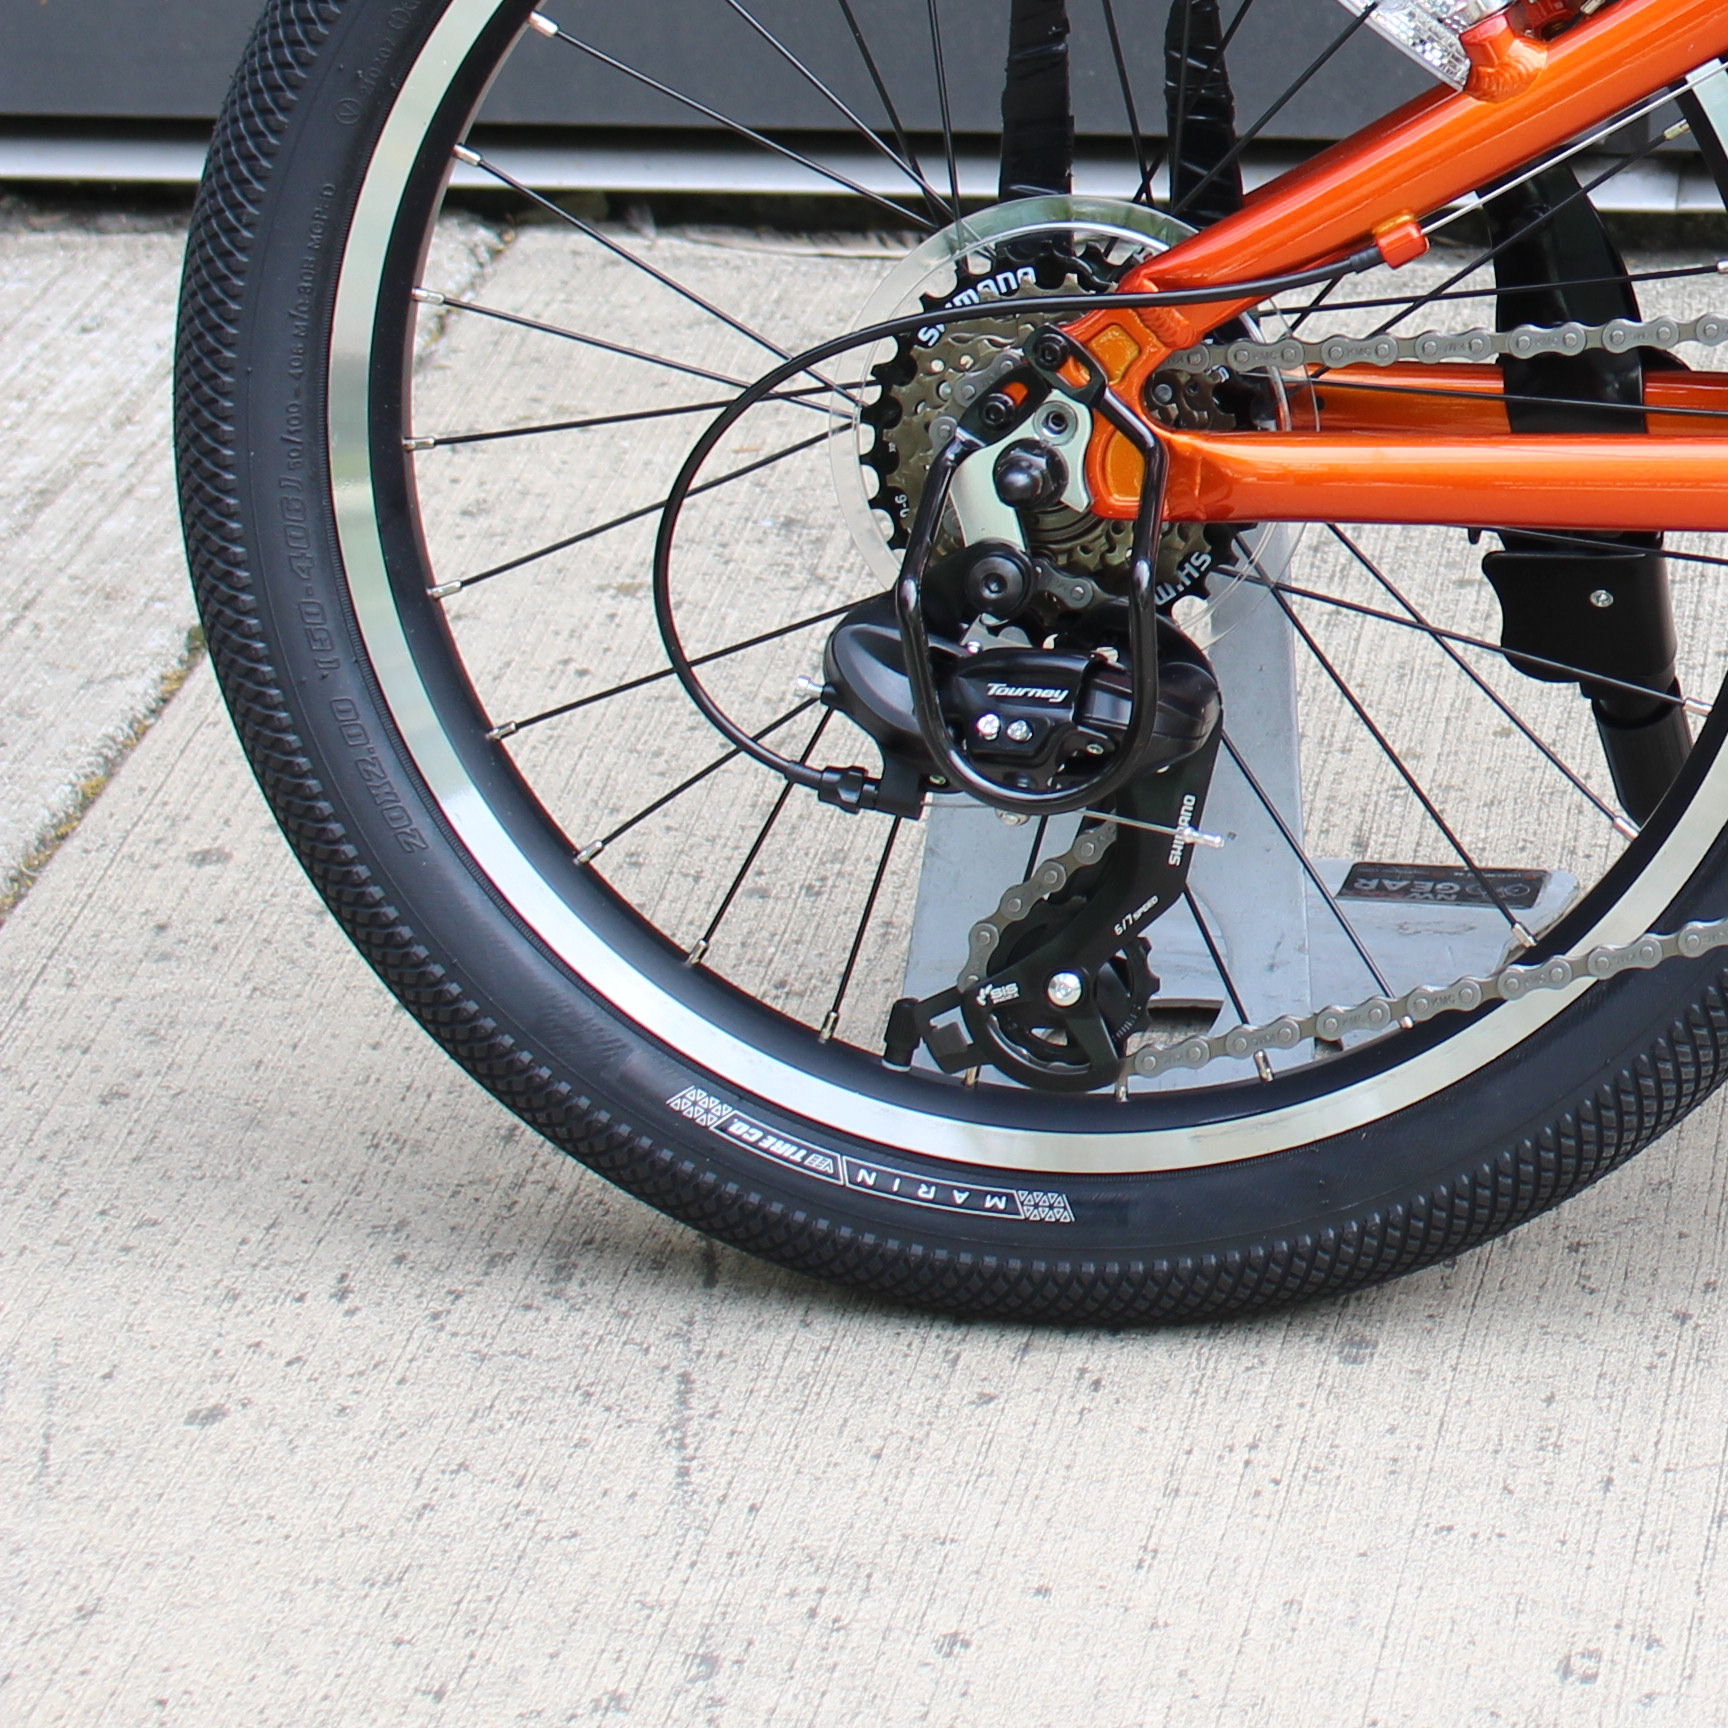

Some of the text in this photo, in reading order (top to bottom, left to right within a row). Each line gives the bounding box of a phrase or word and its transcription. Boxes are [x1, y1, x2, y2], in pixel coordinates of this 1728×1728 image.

[917, 266, 1037, 347] SMANO
[987, 683, 1068, 703] Tourney
[1354, 877, 1461, 895] GEAR
[757, 1132, 809, 1163] TIRE
[857, 1167, 1007, 1210] MARIN
